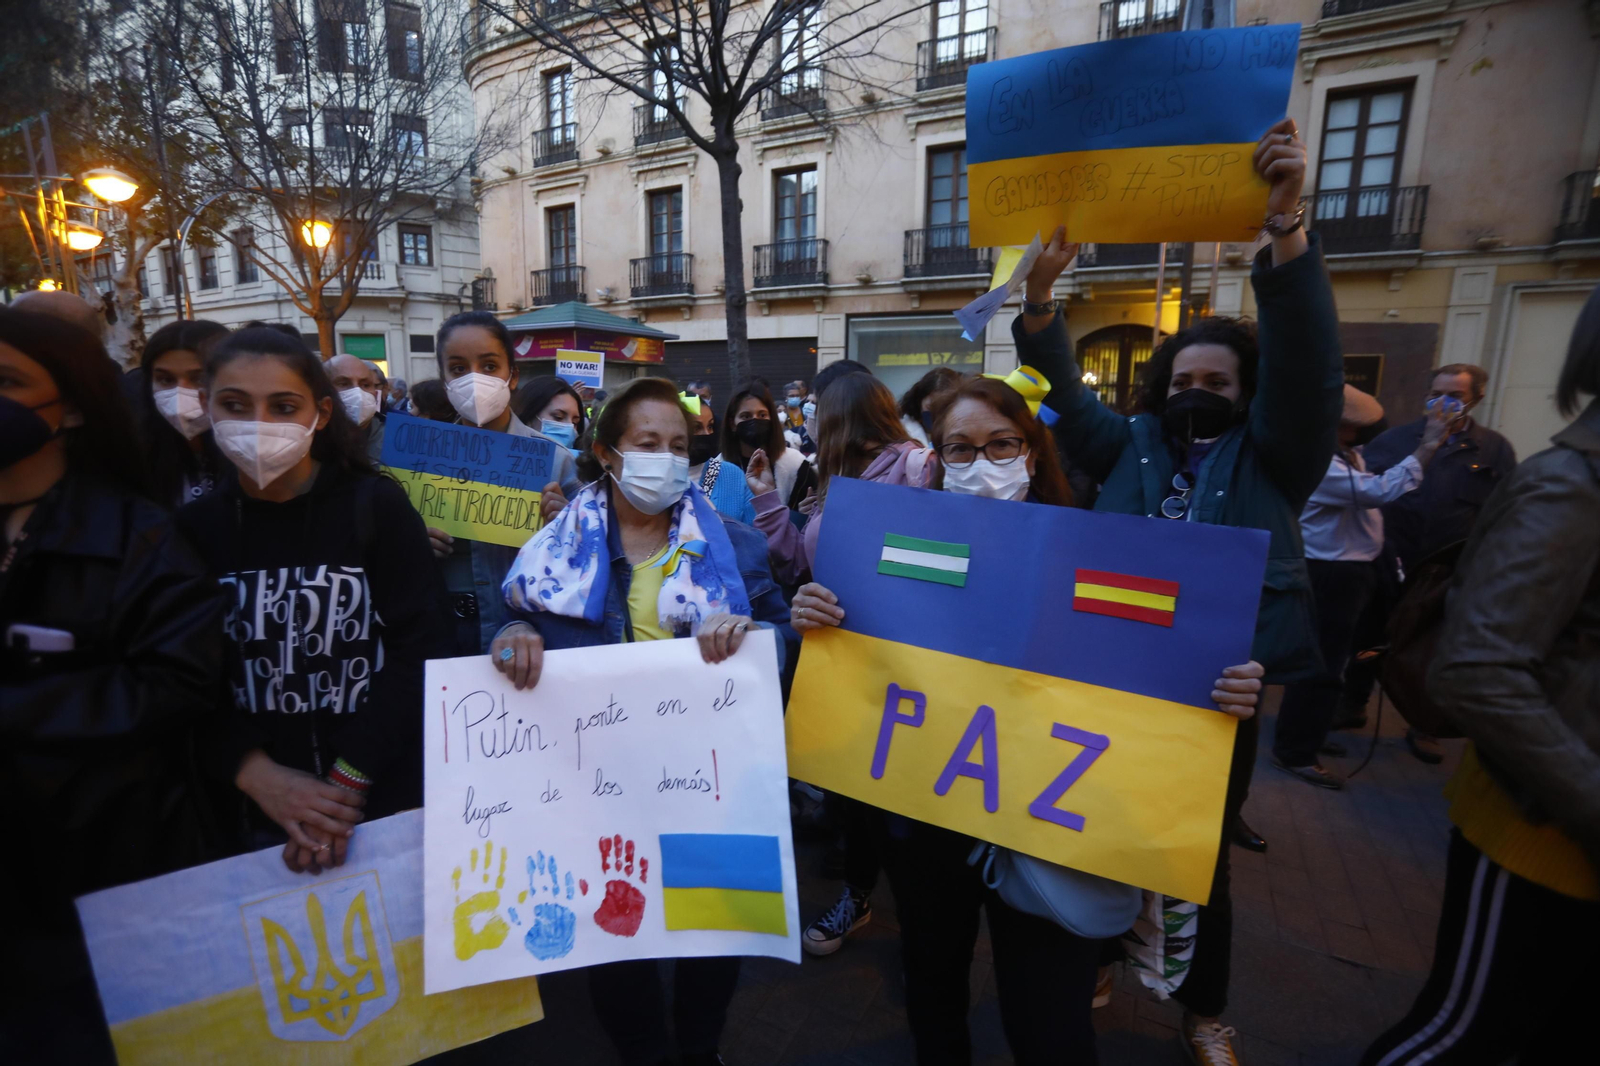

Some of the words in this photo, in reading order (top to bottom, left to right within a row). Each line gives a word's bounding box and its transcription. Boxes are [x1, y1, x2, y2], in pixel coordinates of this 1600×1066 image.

[1173, 33, 1227, 76] NO
[1240, 30, 1299, 71] HAY
[1047, 57, 1093, 111] LA
[1079, 78, 1186, 138] GUERRA
[984, 162, 1112, 217] GANADORES
[560, 361, 573, 369] NO
[575, 362, 598, 371] WAR!
[394, 422, 495, 466] QUEREMOS
[507, 455, 548, 477] ZAR
[487, 470, 527, 493] PUTIN
[574, 692, 629, 771] ponte
[657, 699, 688, 715] en
[713, 678, 737, 711] el
[870, 682, 1111, 833] PAZ
[462, 786, 513, 839] lugar
[540, 779, 563, 804] de
[592, 768, 623, 796] los
[657, 748, 721, 802] demás!
